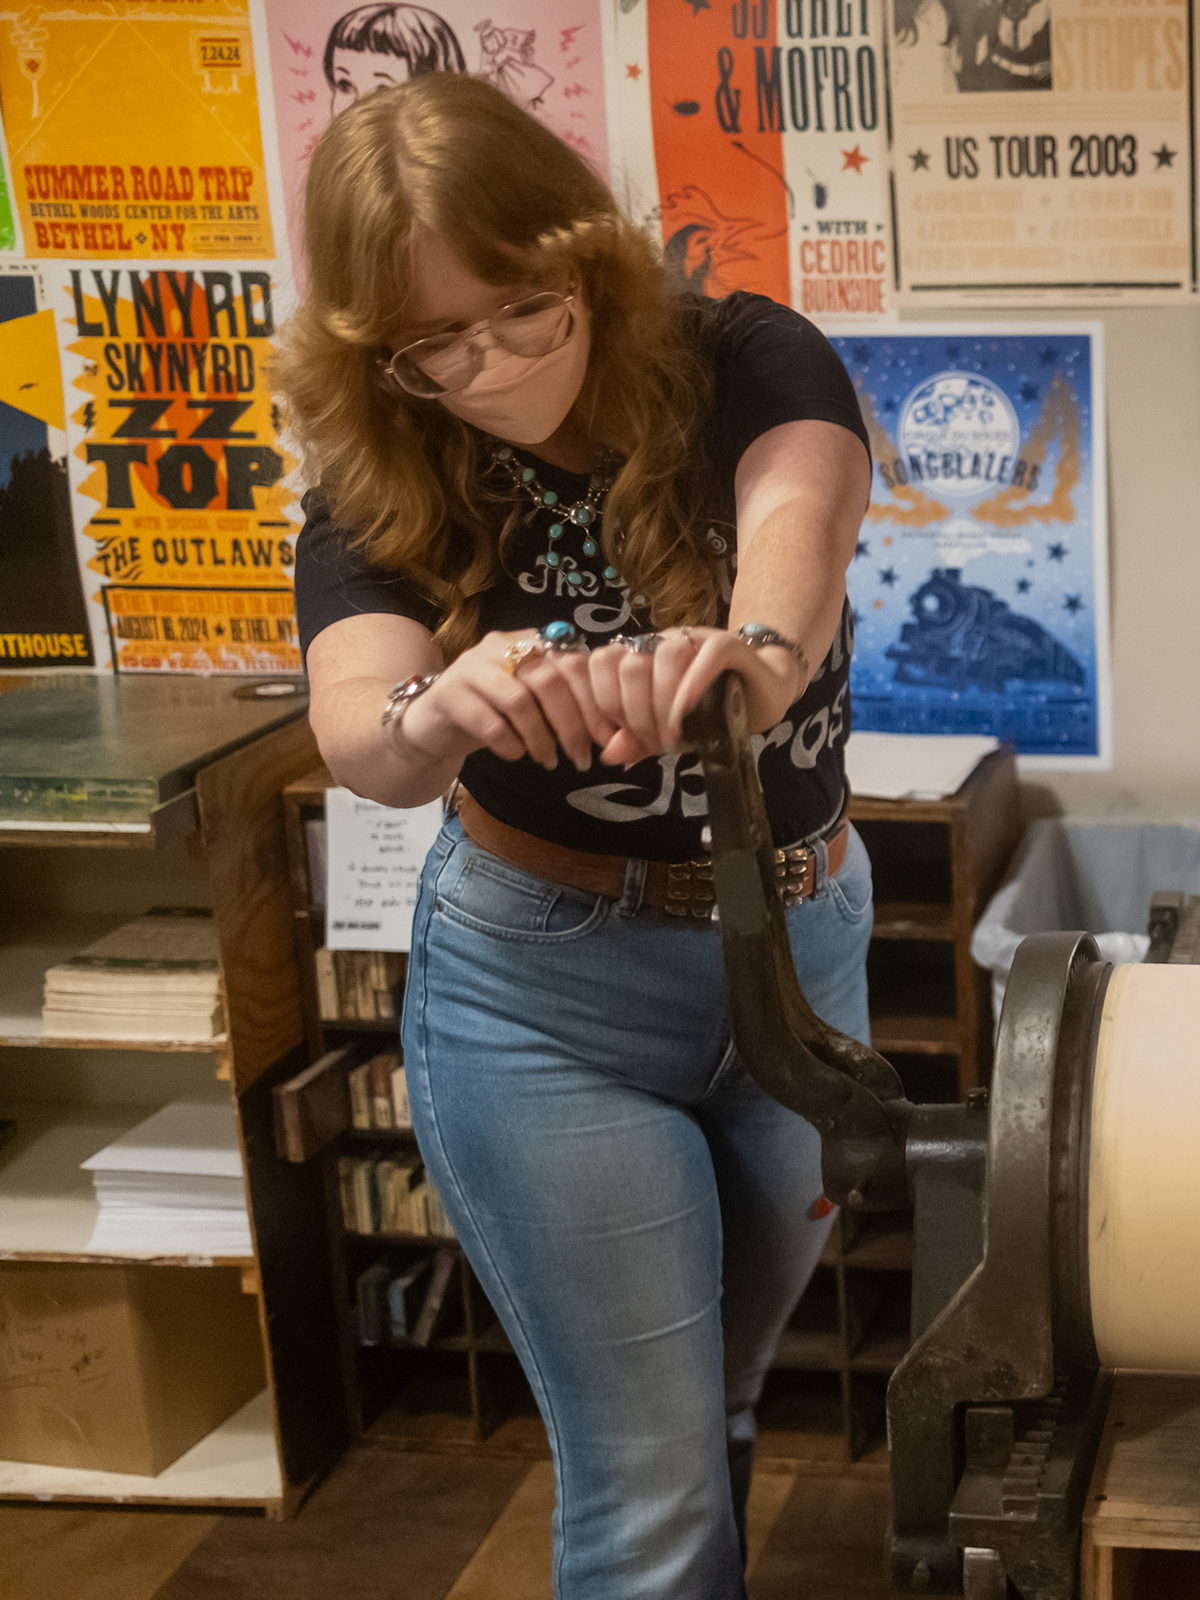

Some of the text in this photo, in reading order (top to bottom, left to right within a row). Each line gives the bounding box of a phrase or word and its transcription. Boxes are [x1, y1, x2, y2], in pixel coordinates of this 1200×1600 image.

[202, 46, 240, 60] 7.24.24
[714, 45, 879, 134] & MOFRO
[945, 133, 1137, 179] US TOUR 2003
[24, 164, 254, 202] SUMMER ROAD TRIP
[228, 206, 259, 220] ARTS
[817, 221, 868, 235] WITH
[34, 221, 132, 250] BETHEL
[151, 223, 187, 250] NY
[801, 239, 886, 275] CEDRIC
[69, 269, 275, 338] LYNYRD
[103, 342, 256, 393] SKYNYRD
[107, 398, 258, 440] ZZ
[85, 443, 285, 511] TOP
[96, 536, 295, 577] THE OUTLAWS
[0, 633, 88, 658] THOUSE
